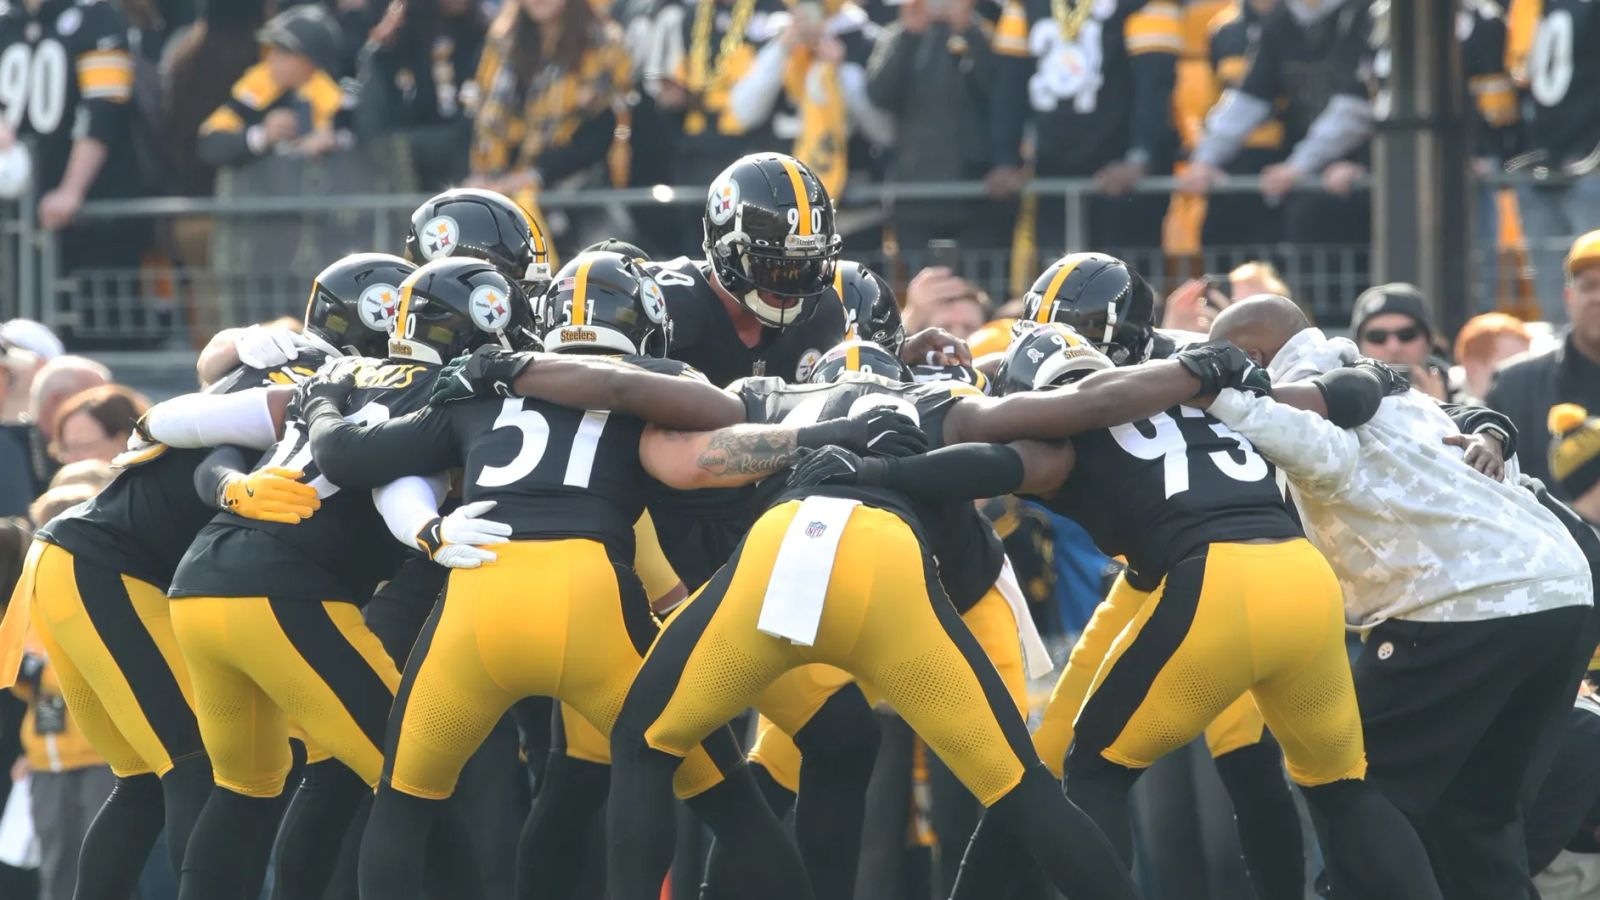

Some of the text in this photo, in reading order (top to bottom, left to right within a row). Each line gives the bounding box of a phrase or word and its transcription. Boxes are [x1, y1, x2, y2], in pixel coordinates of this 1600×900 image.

[0, 39, 67, 134] 90
[787, 207, 821, 235] 90
[562, 299, 595, 327] 51
[1029, 294, 1061, 323] 91
[560, 328, 598, 342] Steelers
[1108, 404, 1268, 500] 93
